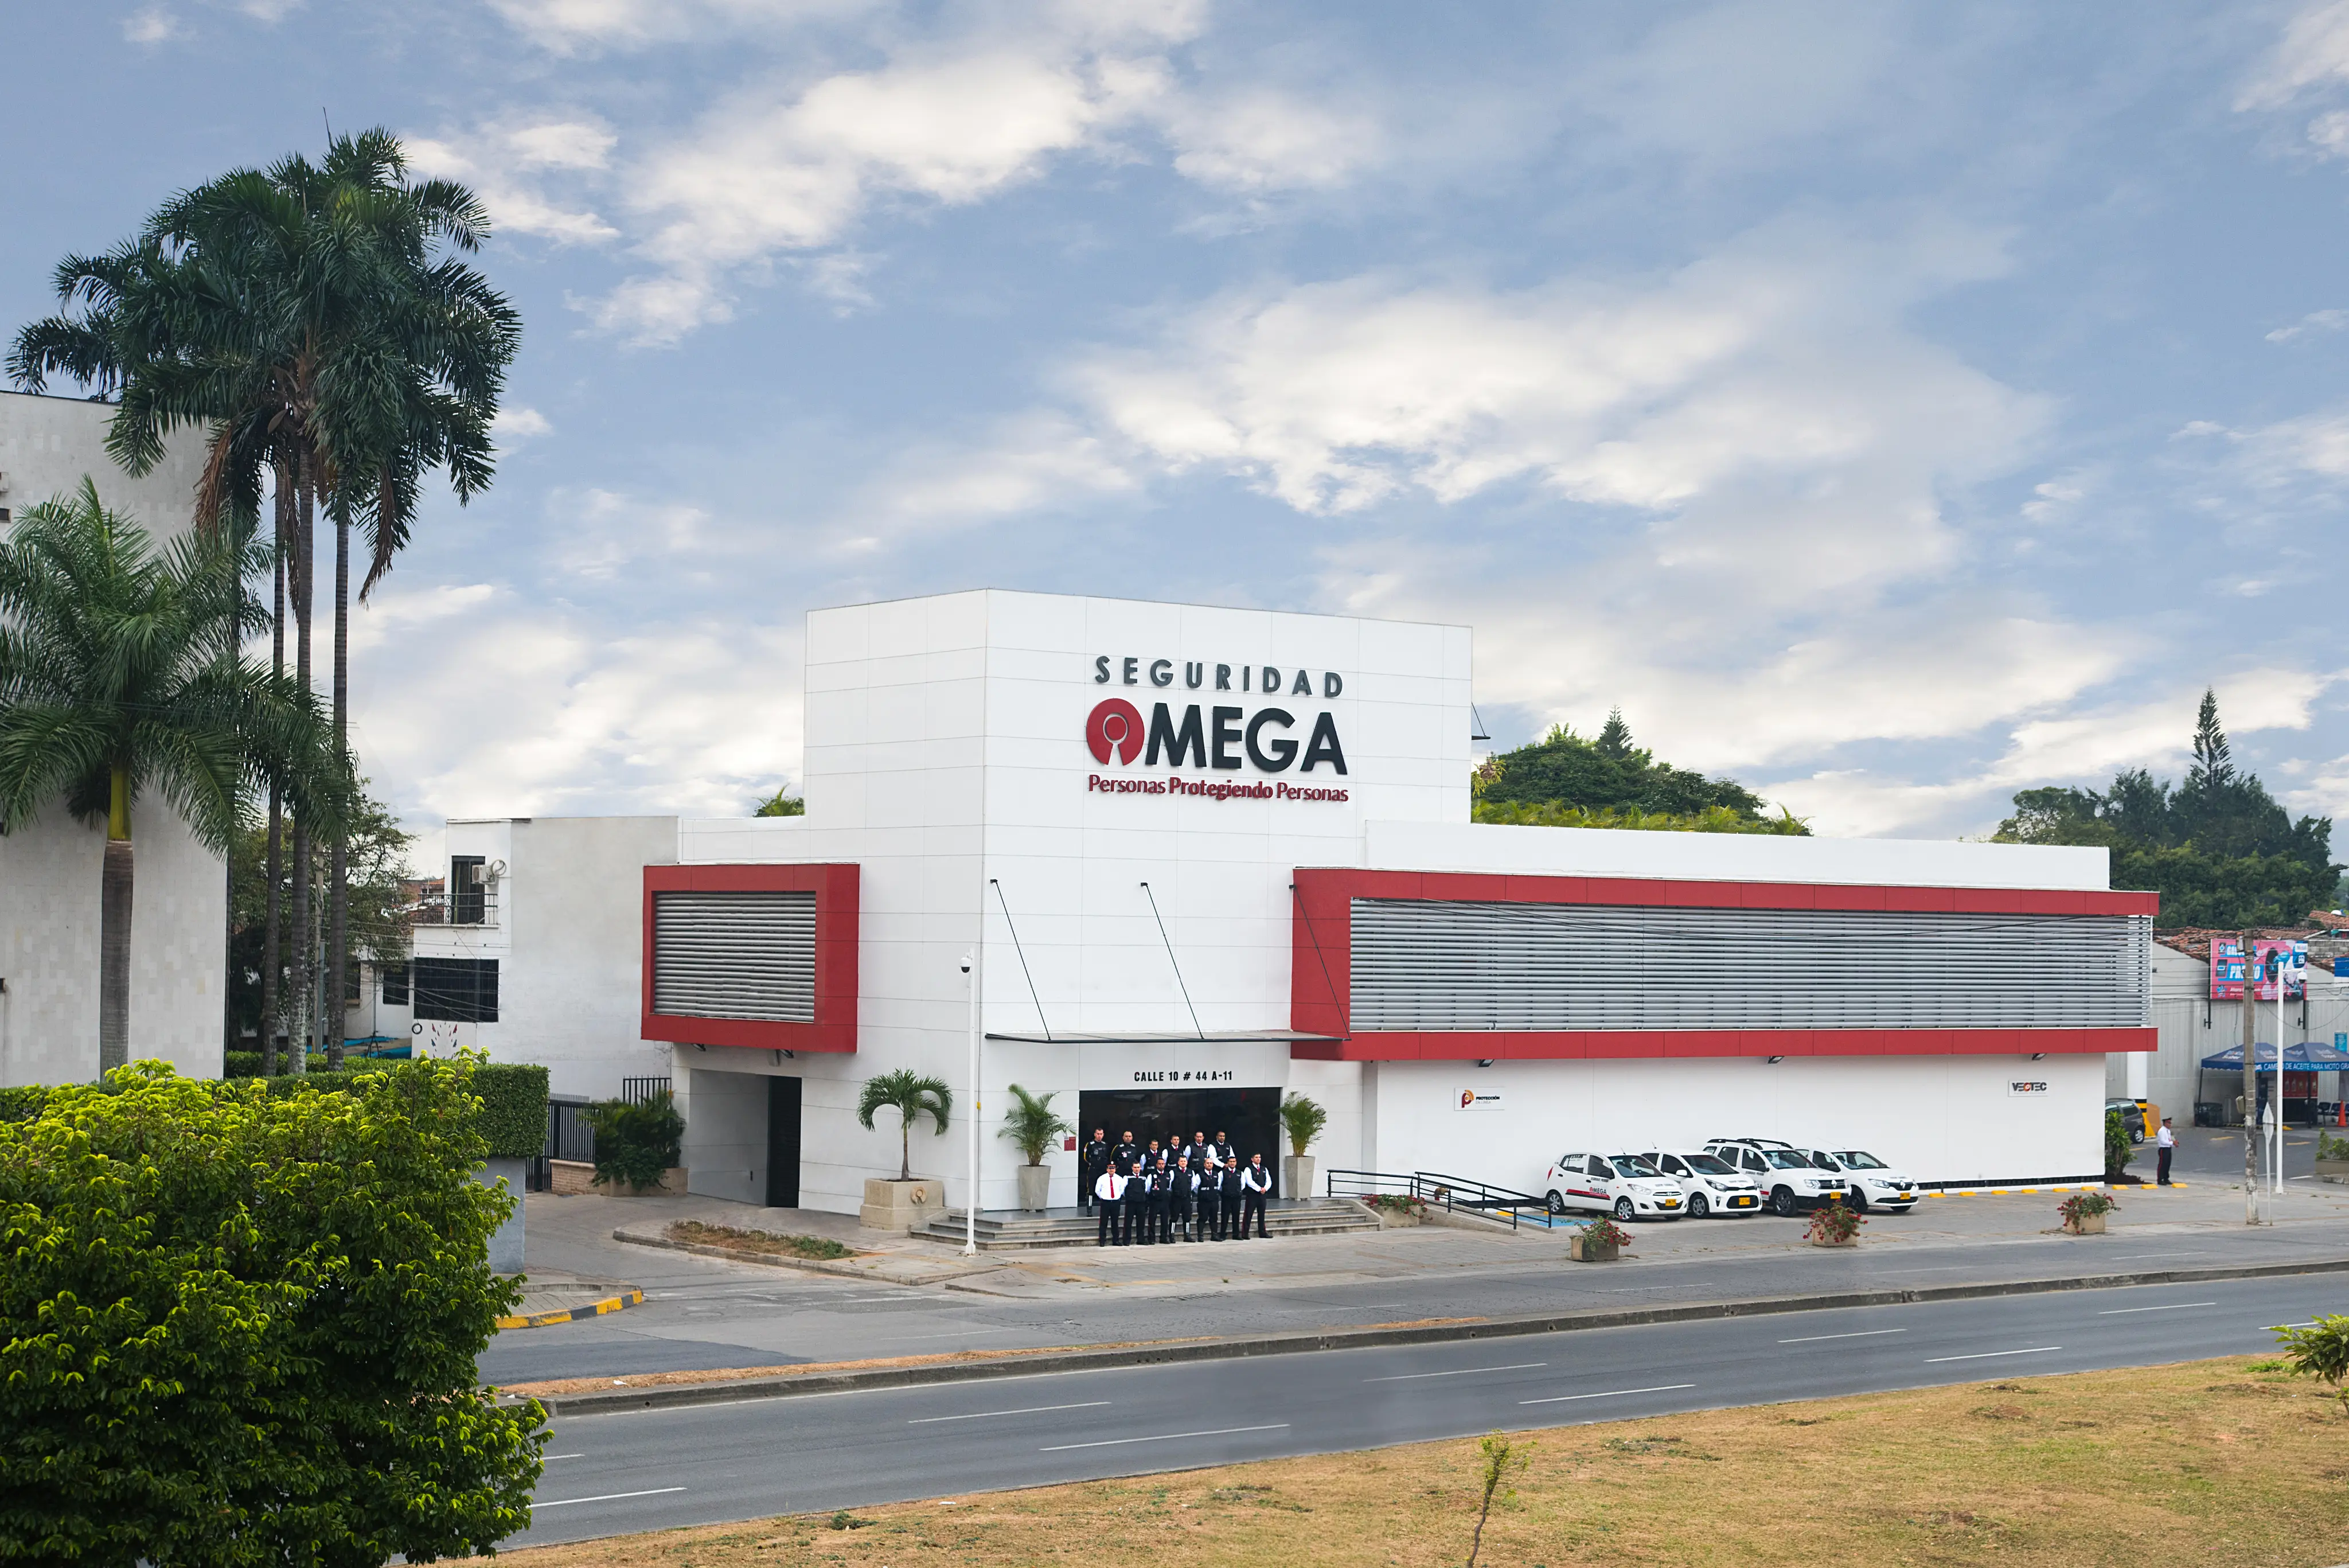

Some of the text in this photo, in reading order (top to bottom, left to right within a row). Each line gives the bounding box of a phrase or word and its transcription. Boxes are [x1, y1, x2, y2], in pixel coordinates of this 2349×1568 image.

[1095, 656, 1343, 697] SEGURIDAD
[1086, 697, 1348, 775] OMEGA
[1088, 774, 1349, 802] Personas Protegiendo Personas
[1134, 1071, 1232, 1082] CALLE 10 # 44 A-11
[2012, 1082, 2047, 1091] VEOTEC
